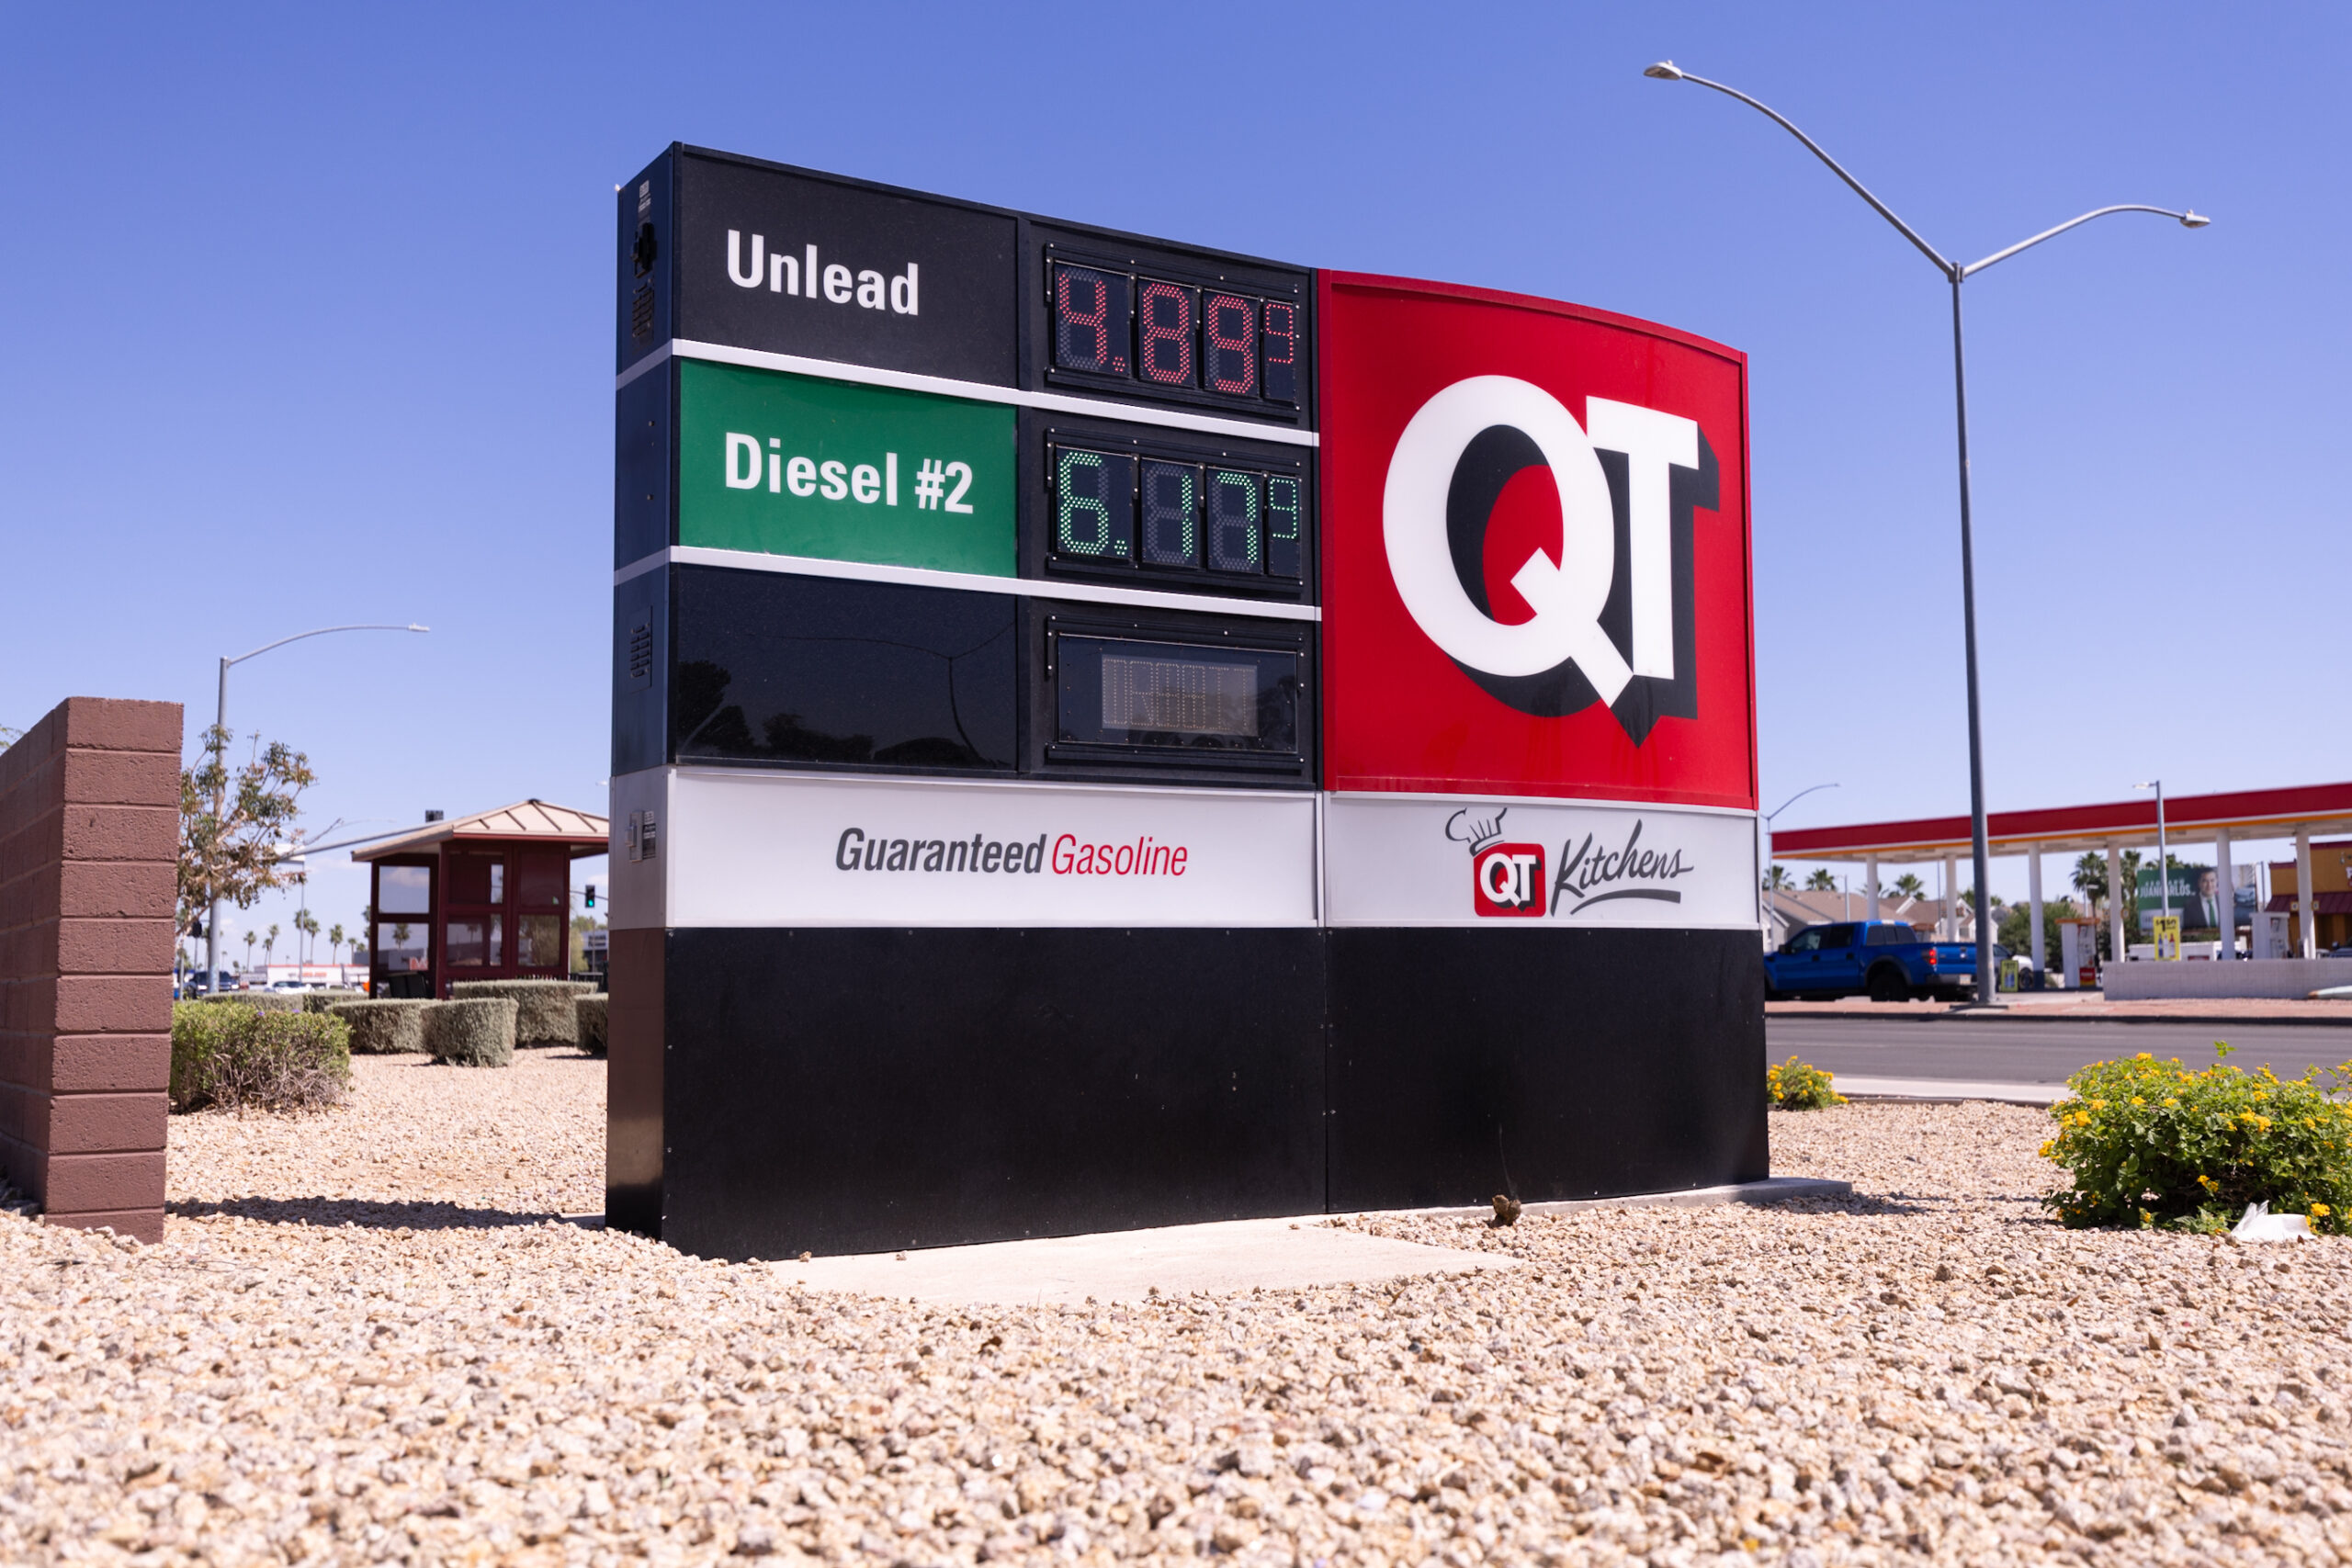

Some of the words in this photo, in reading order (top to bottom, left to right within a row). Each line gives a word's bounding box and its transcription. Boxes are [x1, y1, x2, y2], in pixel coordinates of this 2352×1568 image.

[728, 229, 918, 315] Unlead
[726, 432, 898, 506] Diesel
[915, 458, 973, 513] #2
[1383, 375, 1702, 711] QT
[835, 827, 1047, 874] Guaranteed
[1052, 833, 1188, 875] Gasoline
[1480, 852, 1538, 908] QT
[1550, 818, 1694, 917] Kitchens
